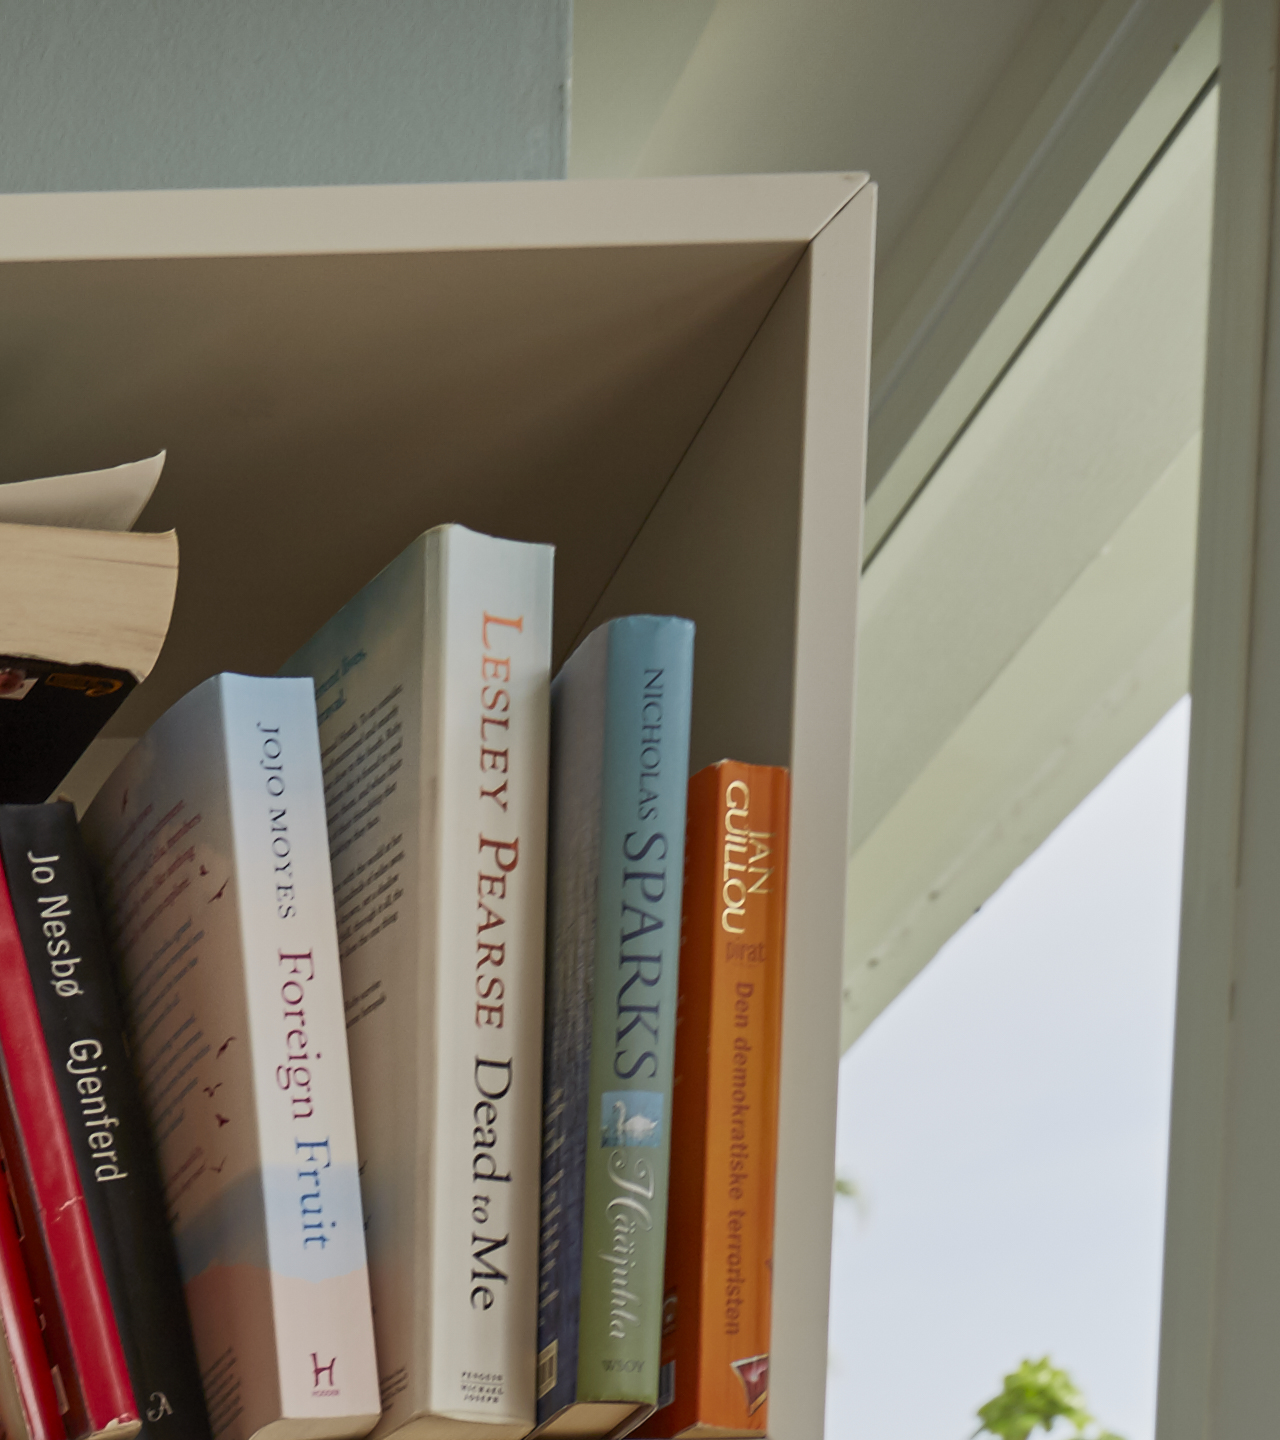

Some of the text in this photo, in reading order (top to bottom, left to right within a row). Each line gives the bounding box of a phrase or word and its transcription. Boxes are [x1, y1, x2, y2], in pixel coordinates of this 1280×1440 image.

[26, 849, 128, 1185] Jo Nesbø Gjenferd
[256, 723, 346, 1252] JOJO MOYES Foreign Fruit
[470, 611, 524, 1312] LESLEY PEARSE Dead to Me
[618, 667, 669, 1081] NICHOLAS SPARKS
